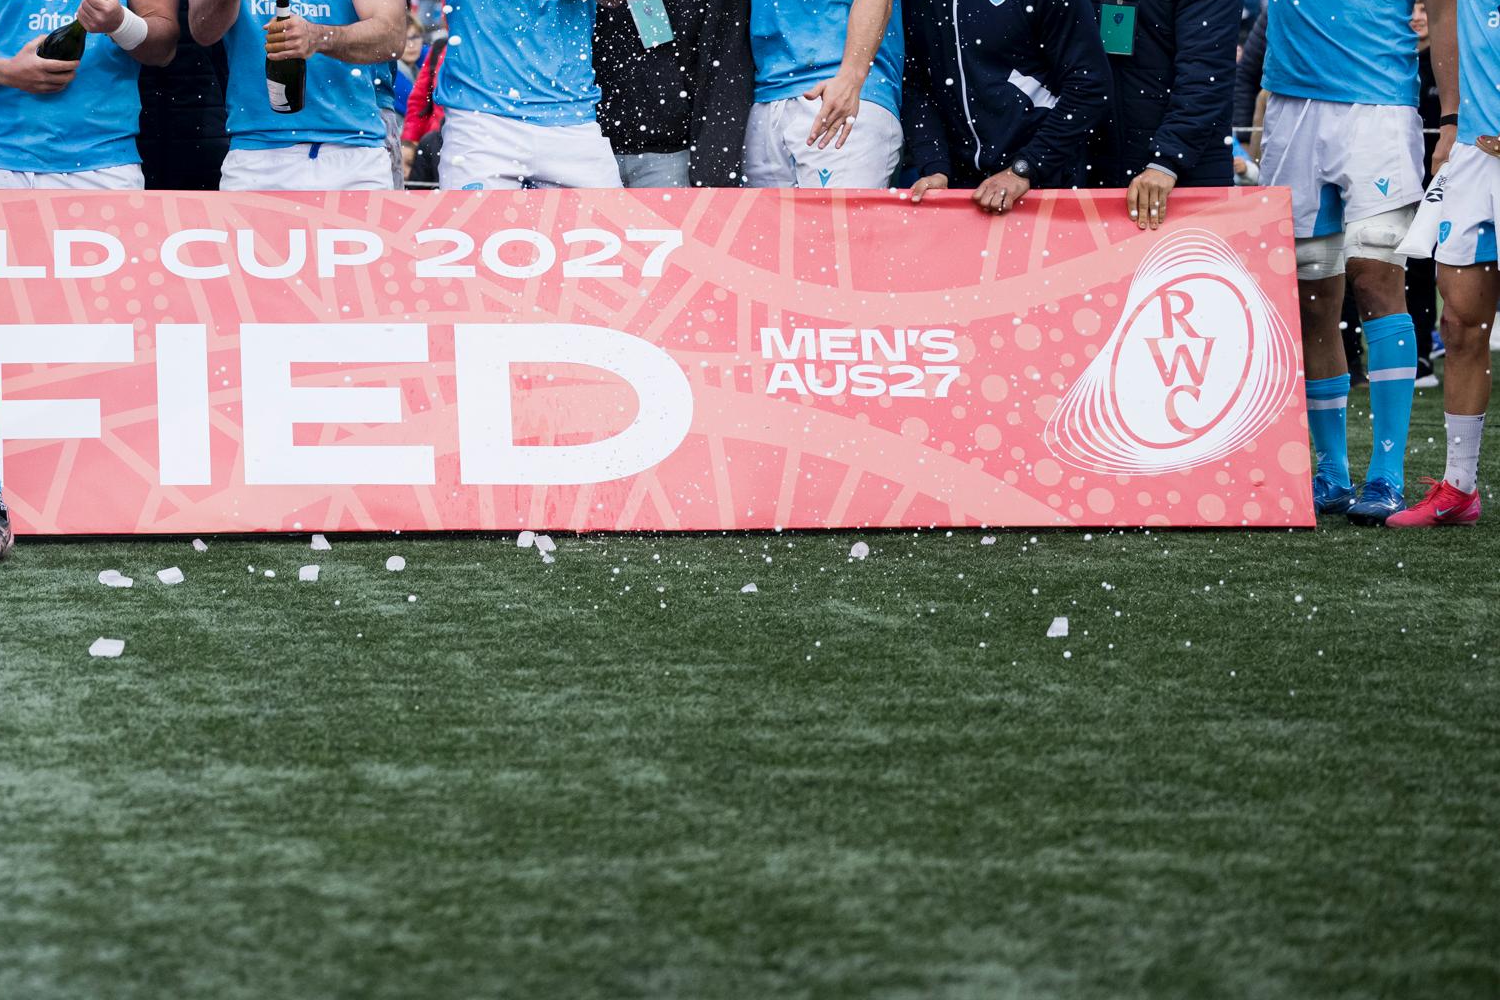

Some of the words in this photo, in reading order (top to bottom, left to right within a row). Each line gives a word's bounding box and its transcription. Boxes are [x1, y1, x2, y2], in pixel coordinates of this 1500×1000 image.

[28, 8, 78, 31] ante
[160, 228, 384, 279] CUP
[416, 228, 683, 279] 2027
[760, 327, 959, 362] MEN'S
[765, 363, 960, 398] AUS27
